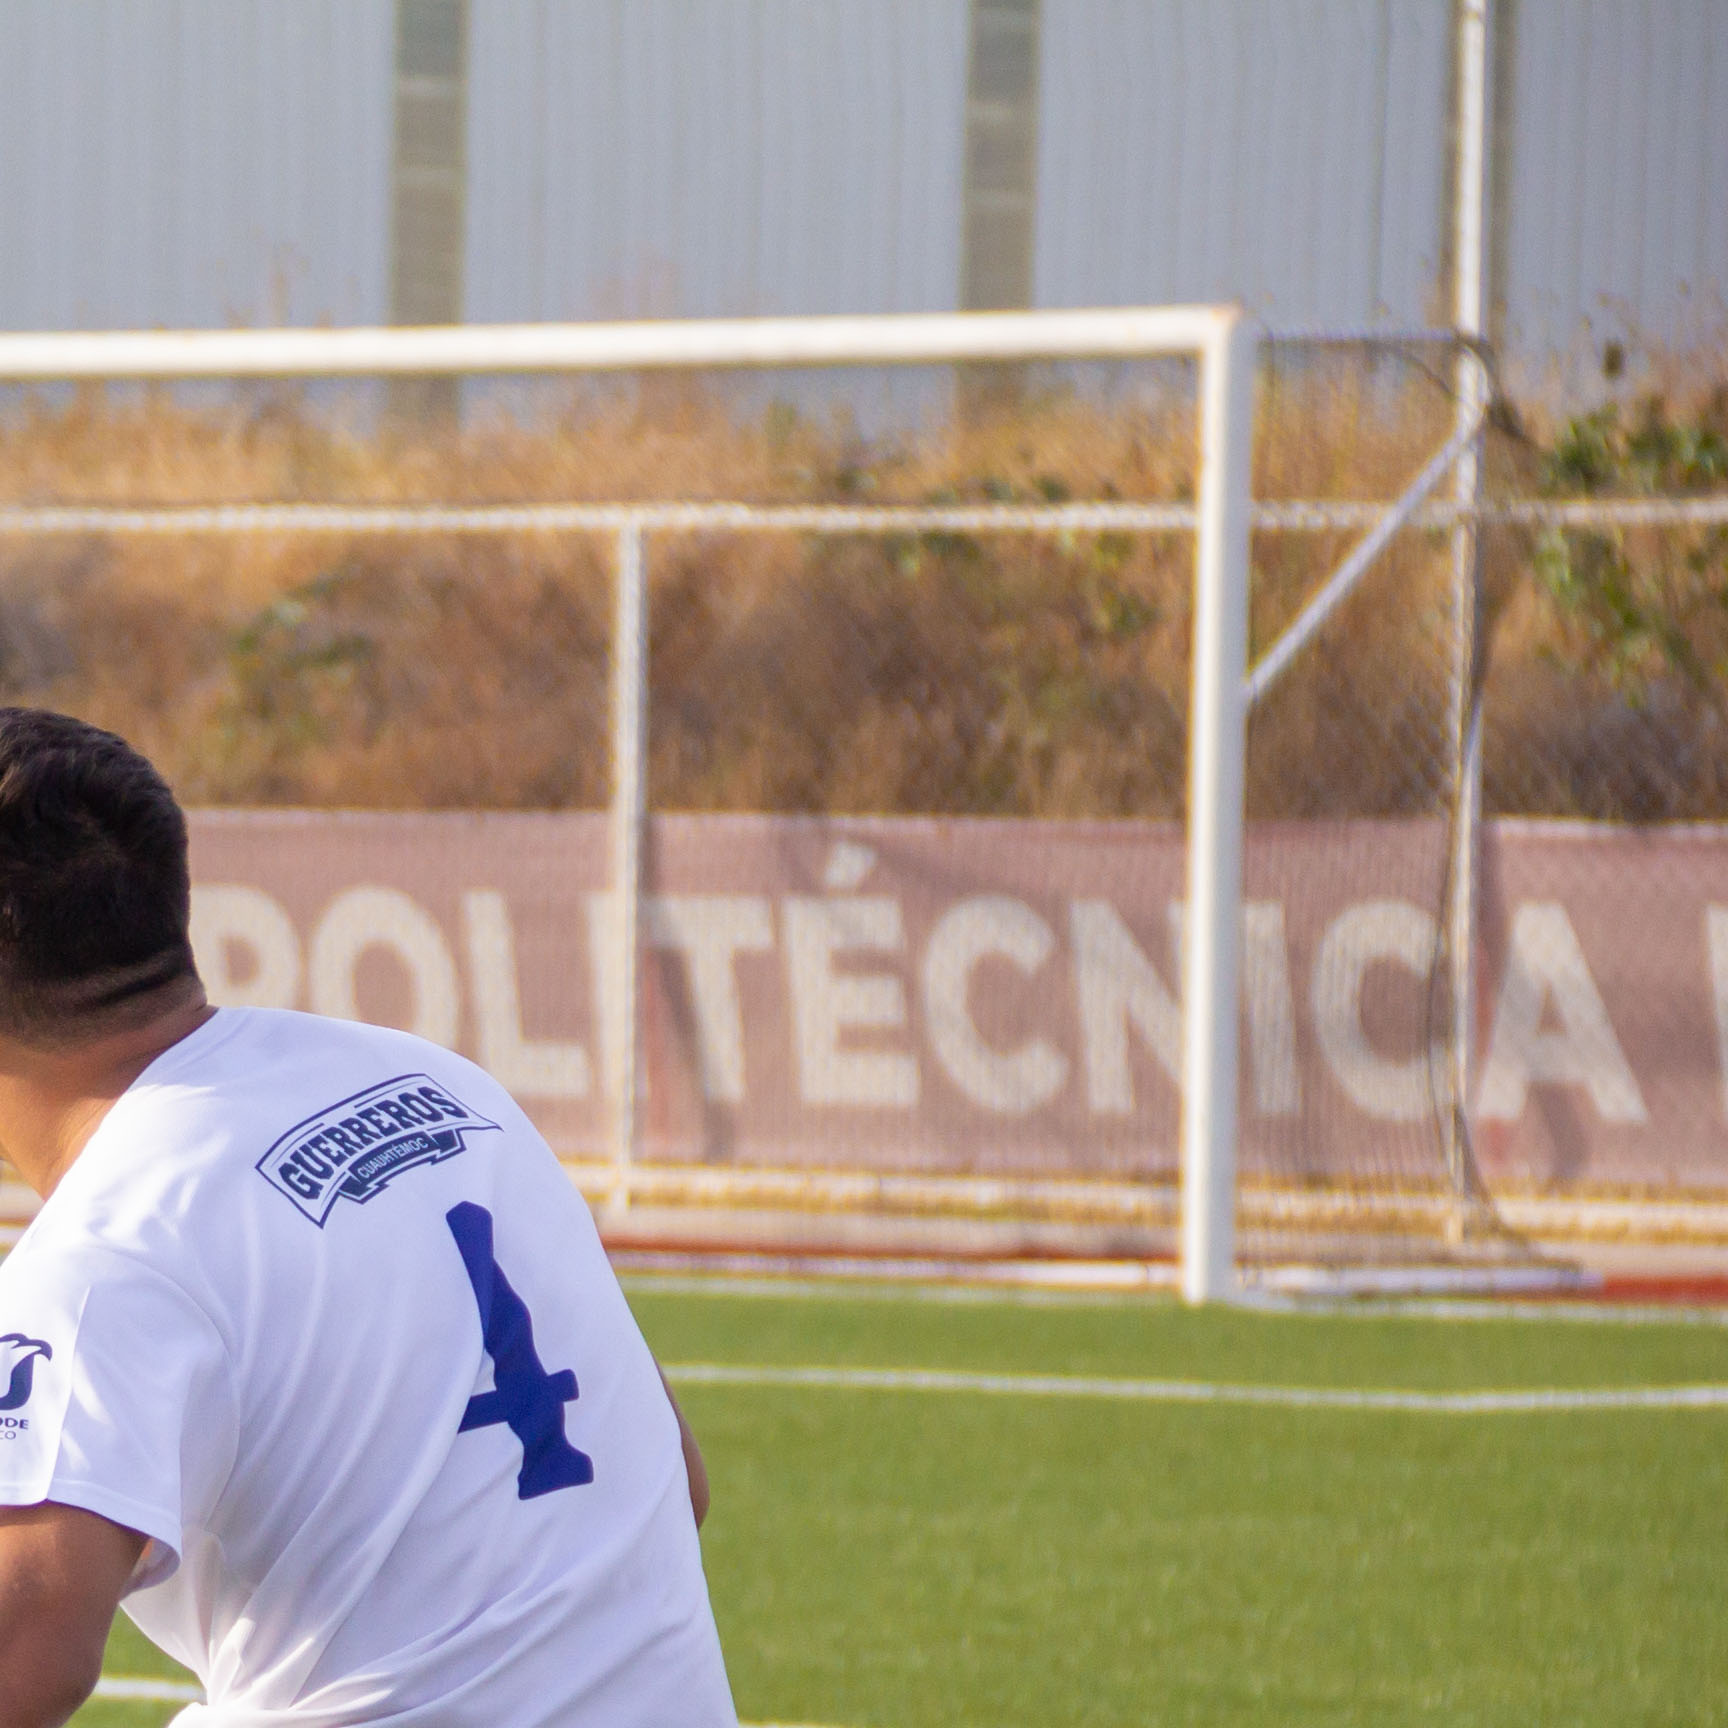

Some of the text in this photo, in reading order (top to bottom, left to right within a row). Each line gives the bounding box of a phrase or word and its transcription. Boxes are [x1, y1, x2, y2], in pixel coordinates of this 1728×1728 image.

[278, 1086, 469, 1199] GUERREROS
[357, 1137, 429, 1179] CUAUHTÉMOC
[445, 1200, 594, 1500] 4
